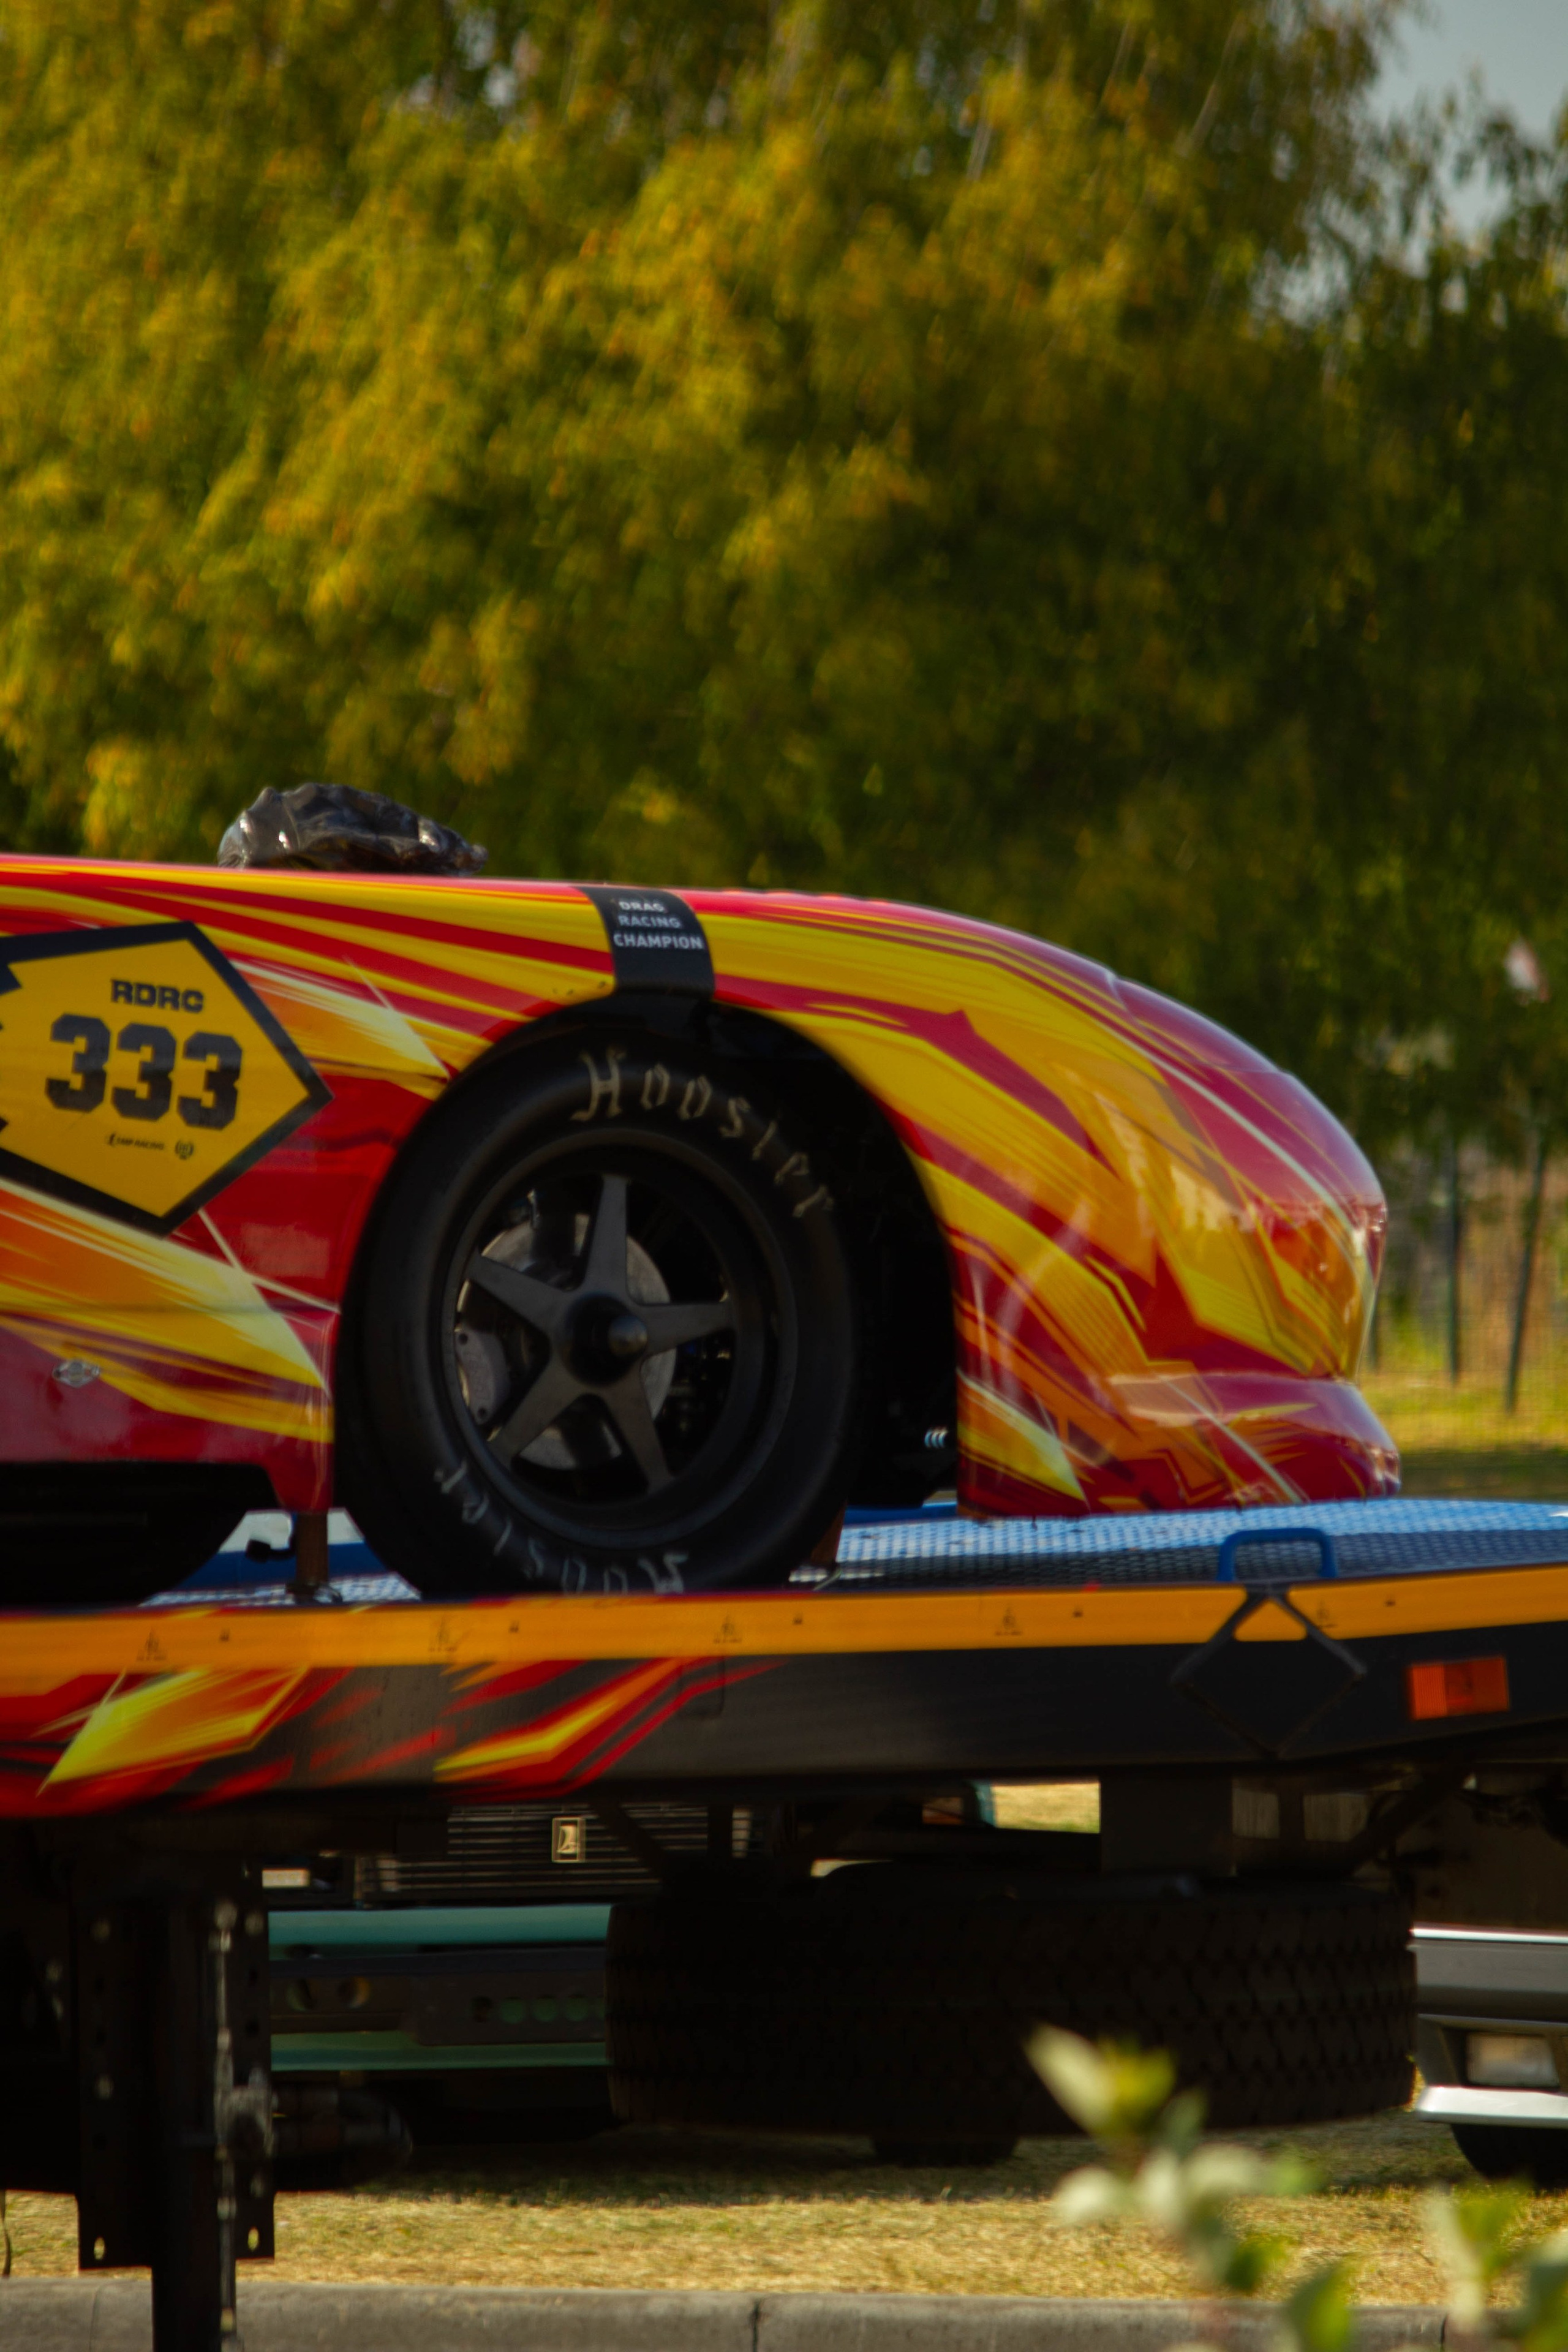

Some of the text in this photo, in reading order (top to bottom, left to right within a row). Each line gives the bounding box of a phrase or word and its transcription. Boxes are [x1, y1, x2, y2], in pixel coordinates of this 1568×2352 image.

[618, 900, 666, 913] DRAG
[617, 914, 682, 929] RACING
[613, 932, 704, 949] CHAMPION
[111, 979, 204, 1013] RDRC
[44, 1013, 243, 1131] 333
